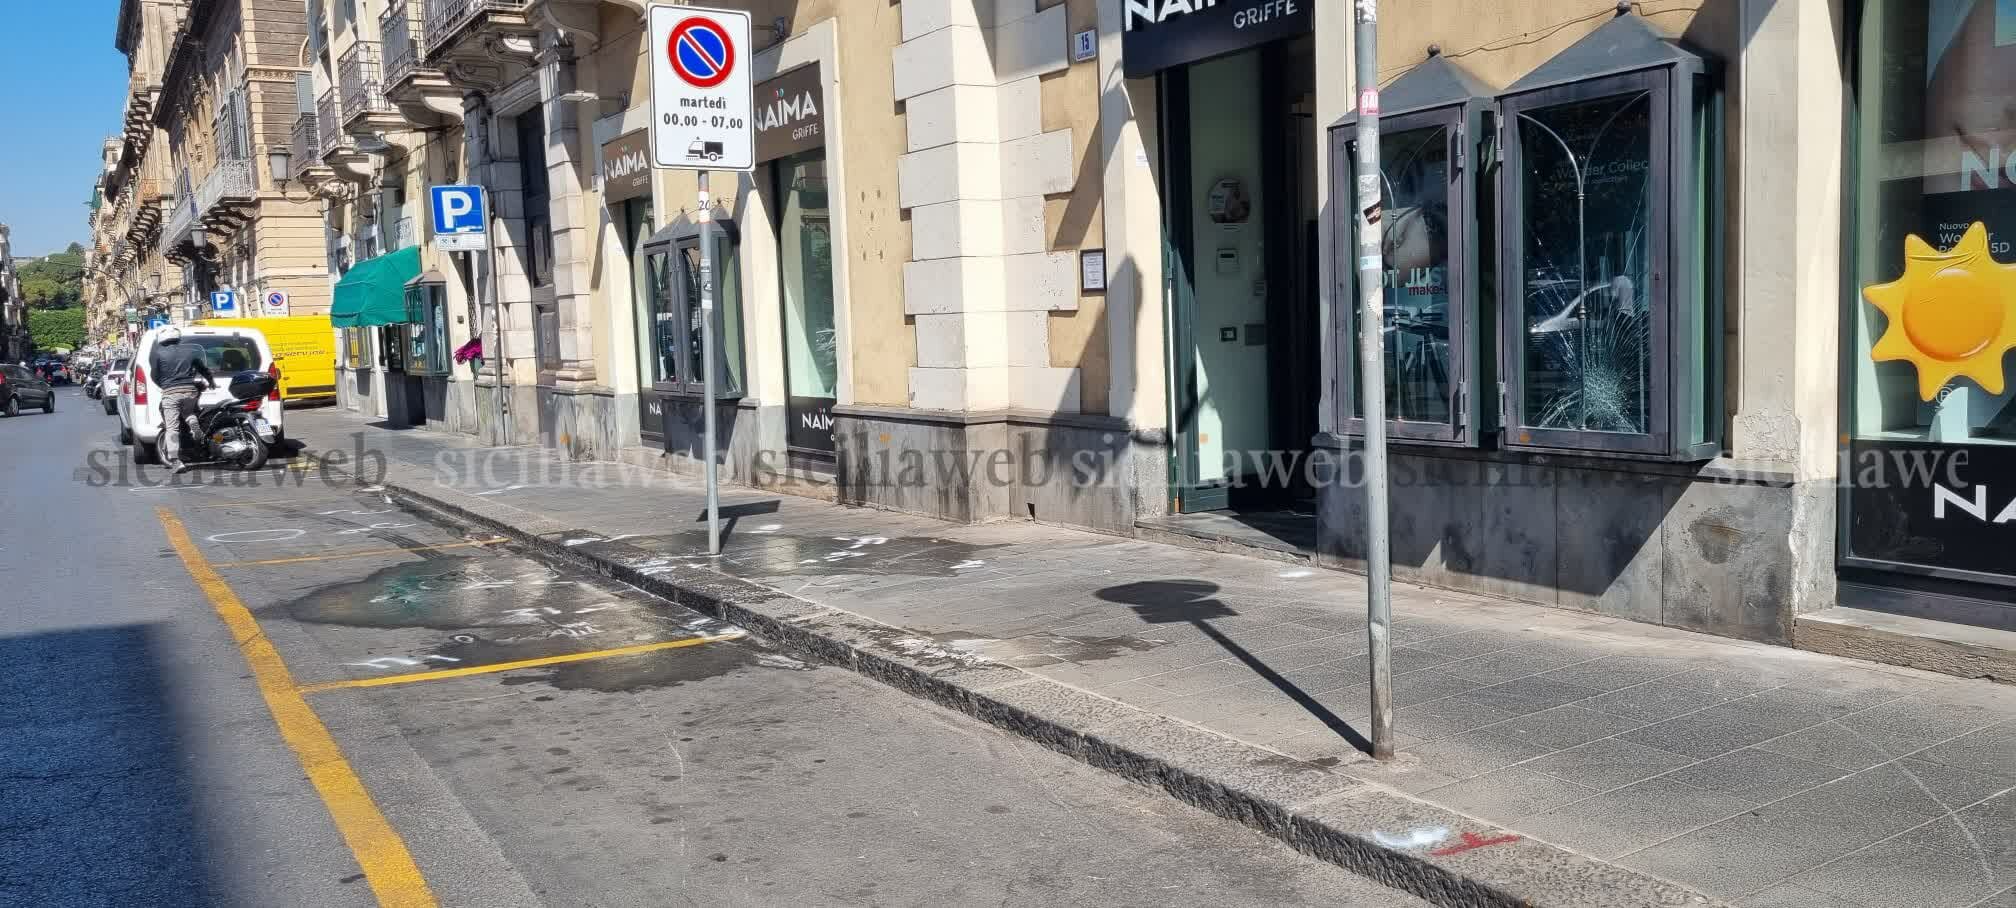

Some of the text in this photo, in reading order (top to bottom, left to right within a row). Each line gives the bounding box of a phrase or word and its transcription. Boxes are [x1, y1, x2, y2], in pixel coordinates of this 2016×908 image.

[1081, 33, 1090, 51] 15
[663, 113, 698, 127] 00.00
[711, 116, 743, 129] 07.00
[441, 191, 473, 229] P
[1939, 222, 1969, 230] Nuovo
[1991, 242, 2010, 253] 5D
[1405, 266, 1447, 288] JUS
[216, 293, 229, 309] P
